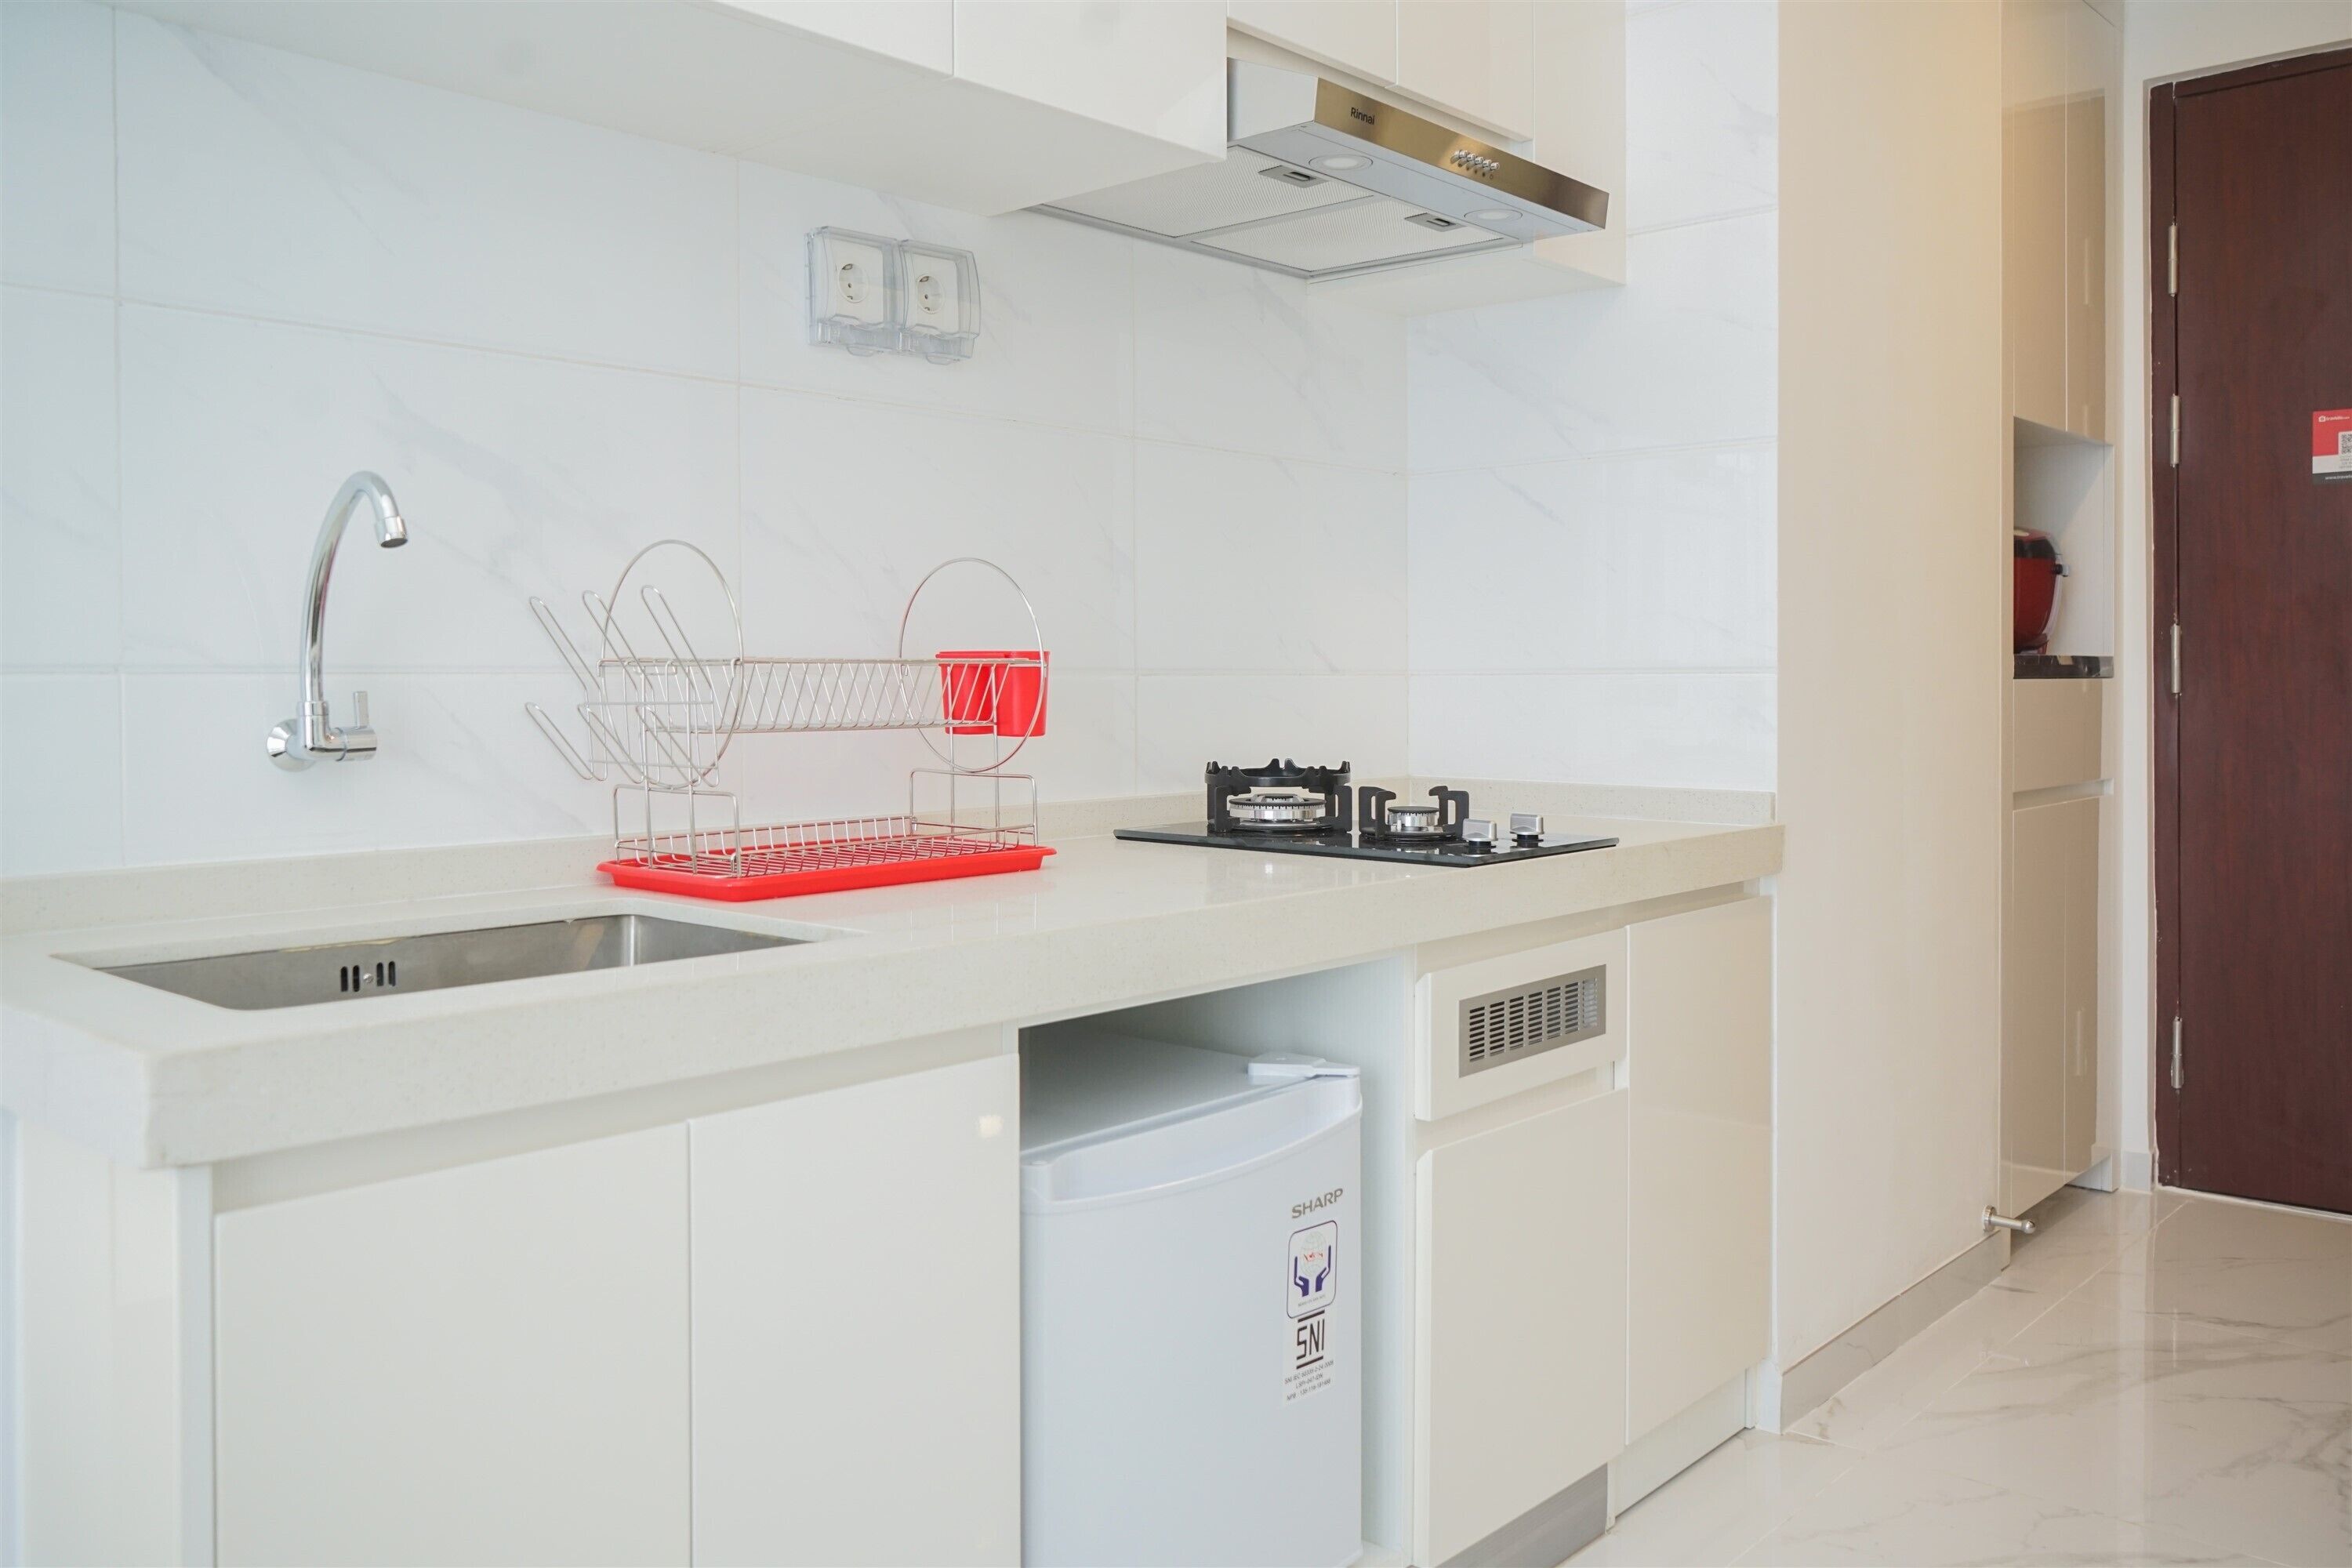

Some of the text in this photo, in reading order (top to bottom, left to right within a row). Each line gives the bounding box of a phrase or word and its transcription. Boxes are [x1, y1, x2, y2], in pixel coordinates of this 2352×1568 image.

[1350, 107, 1375, 125] Rinnai
[1291, 1188, 1343, 1219] SHARP
[1296, 1319, 1325, 1360] SNI
